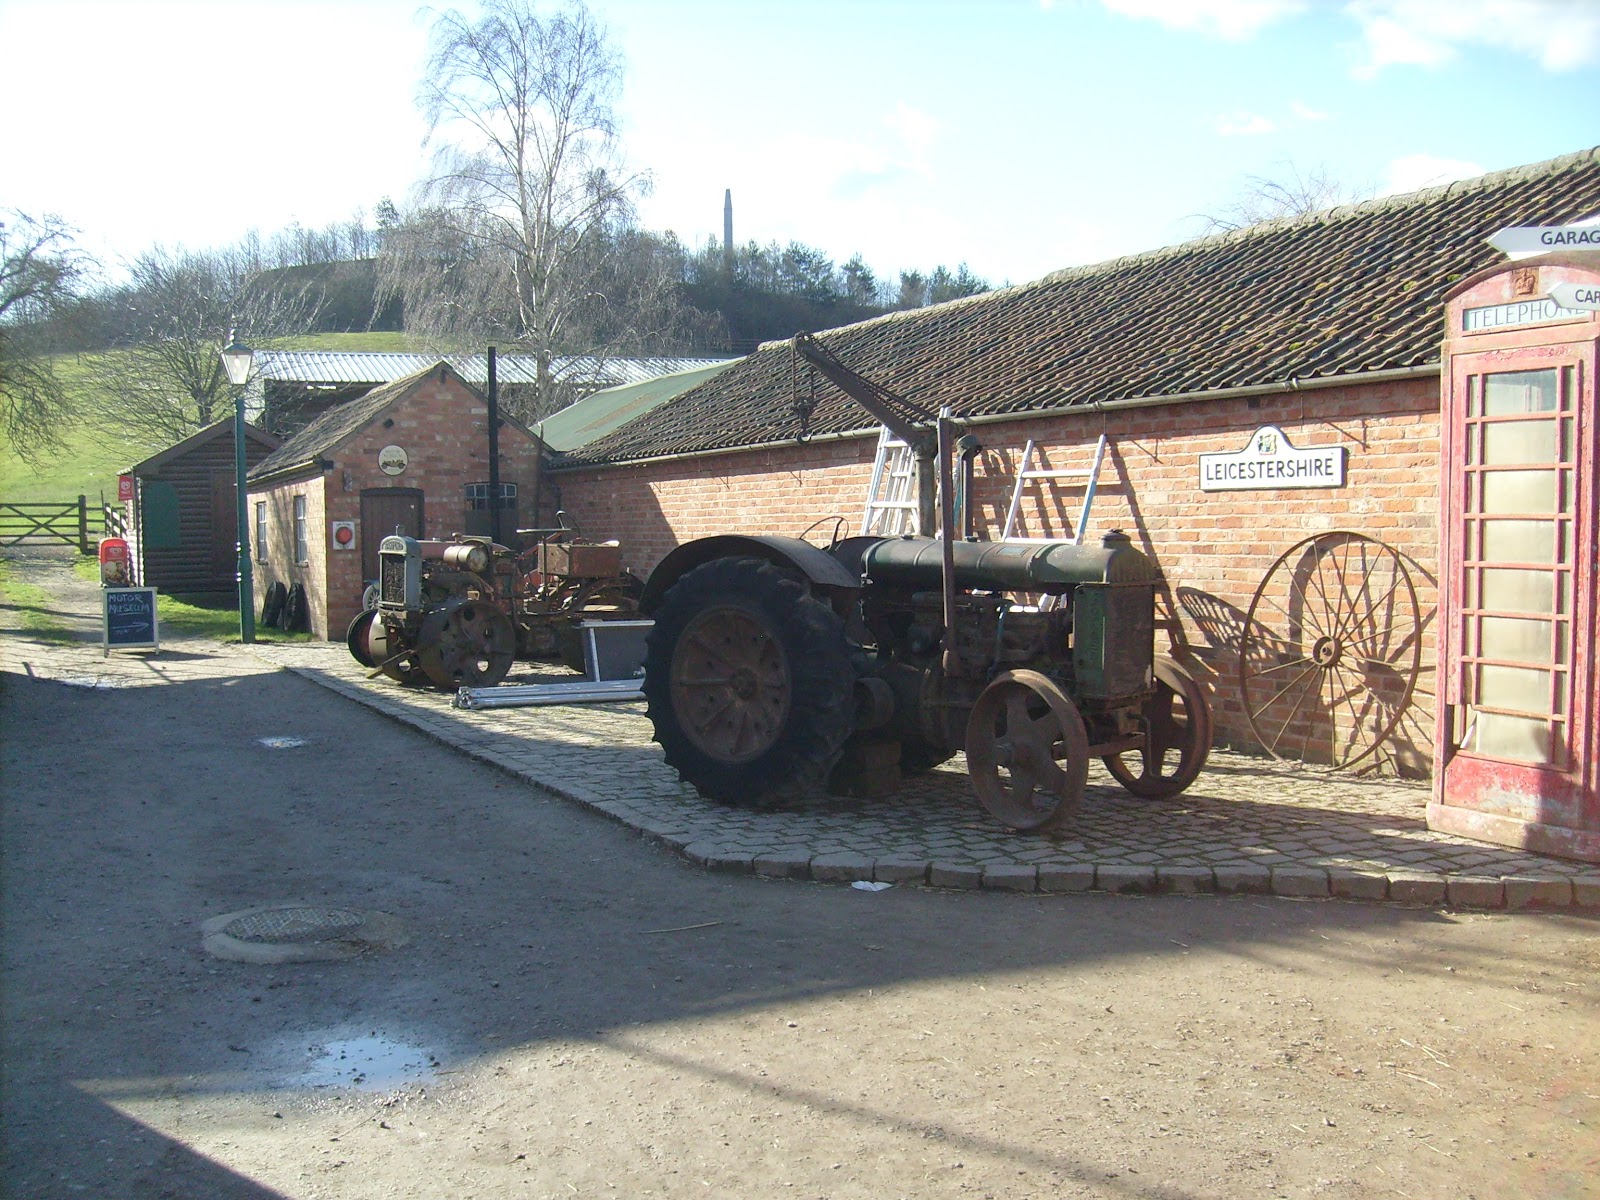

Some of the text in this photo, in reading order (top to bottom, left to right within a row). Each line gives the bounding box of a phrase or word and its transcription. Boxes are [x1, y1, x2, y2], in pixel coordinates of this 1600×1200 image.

[1541, 230, 1600, 245] GARAG
[1575, 289, 1600, 304] CAR
[1206, 458, 1334, 481] LEICESTERSHIRE
[108, 594, 144, 604] MOTOR
[108, 603, 151, 614] MUSEUM
